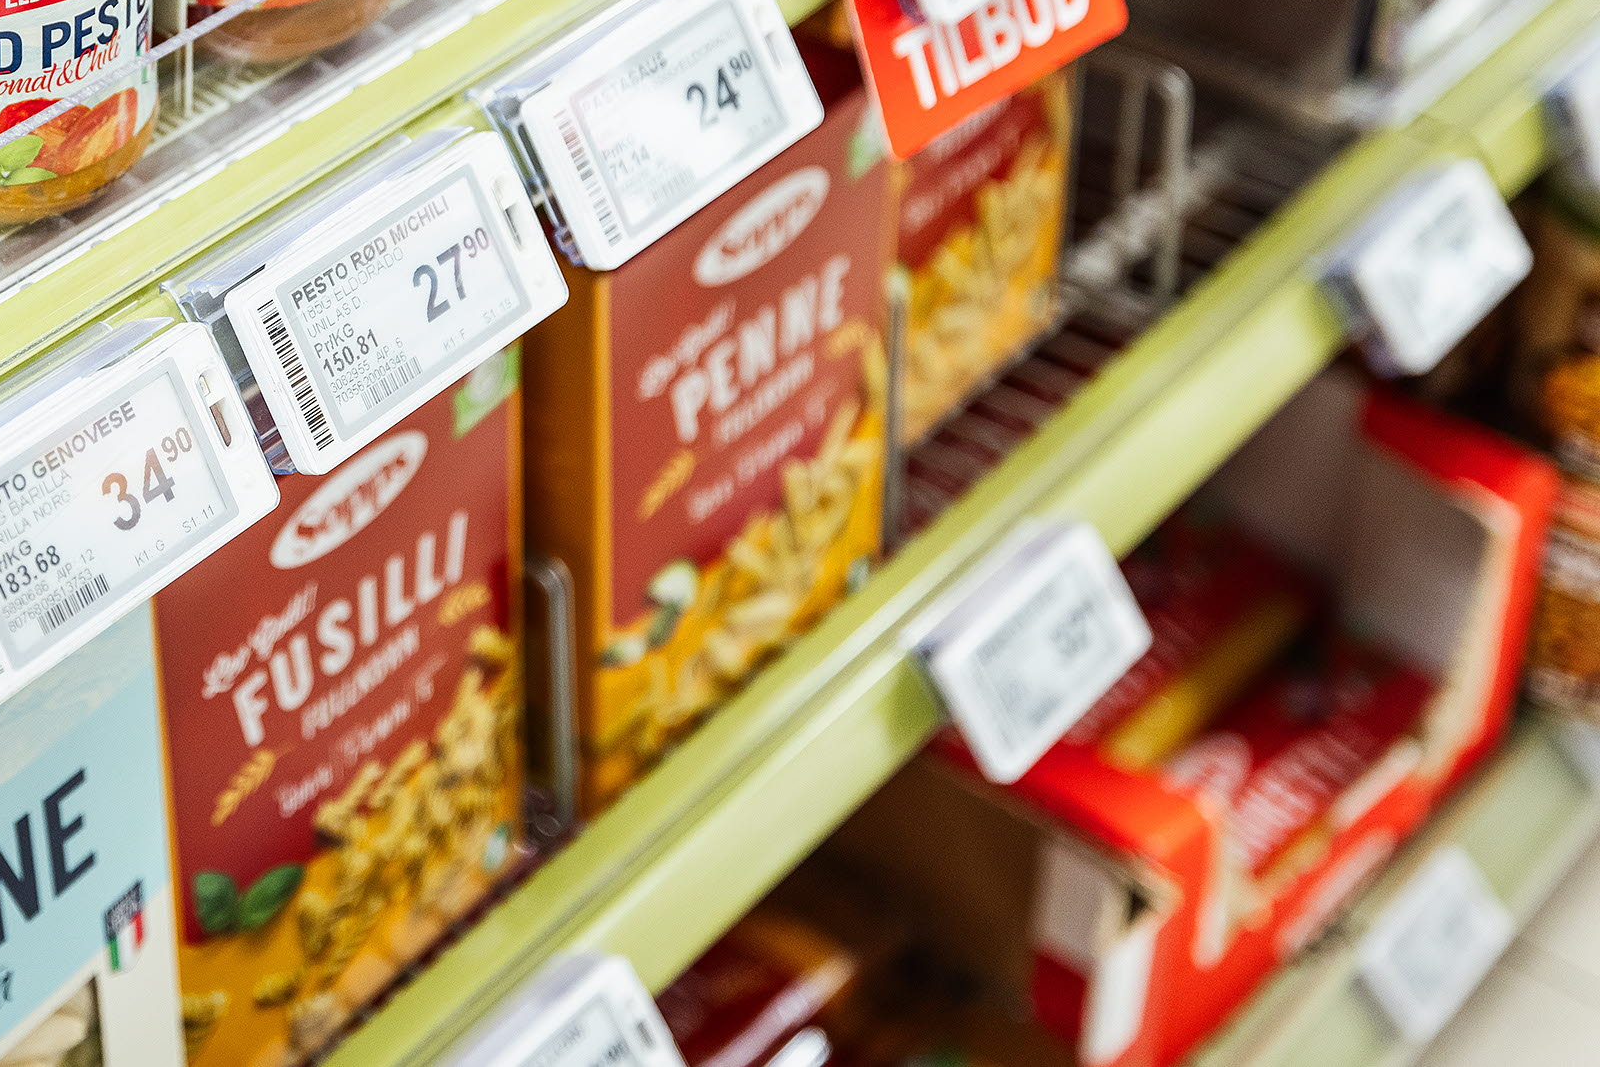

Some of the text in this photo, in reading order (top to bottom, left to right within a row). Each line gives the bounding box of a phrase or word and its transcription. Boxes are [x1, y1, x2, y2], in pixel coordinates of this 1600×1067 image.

[291, 194, 450, 310] PESTO RØD M/CHILI
[301, 246, 404, 323] 185G ELDORADO
[307, 301, 352, 339] UNIL AS
[314, 322, 355, 359] Pr/KG
[322, 328, 379, 378] 150.81
[671, 254, 852, 444] PENNE
[31, 400, 137, 478] GENOVESE
[8, 470, 72, 517] BARILLA
[232, 510, 469, 748] FUSILLI
